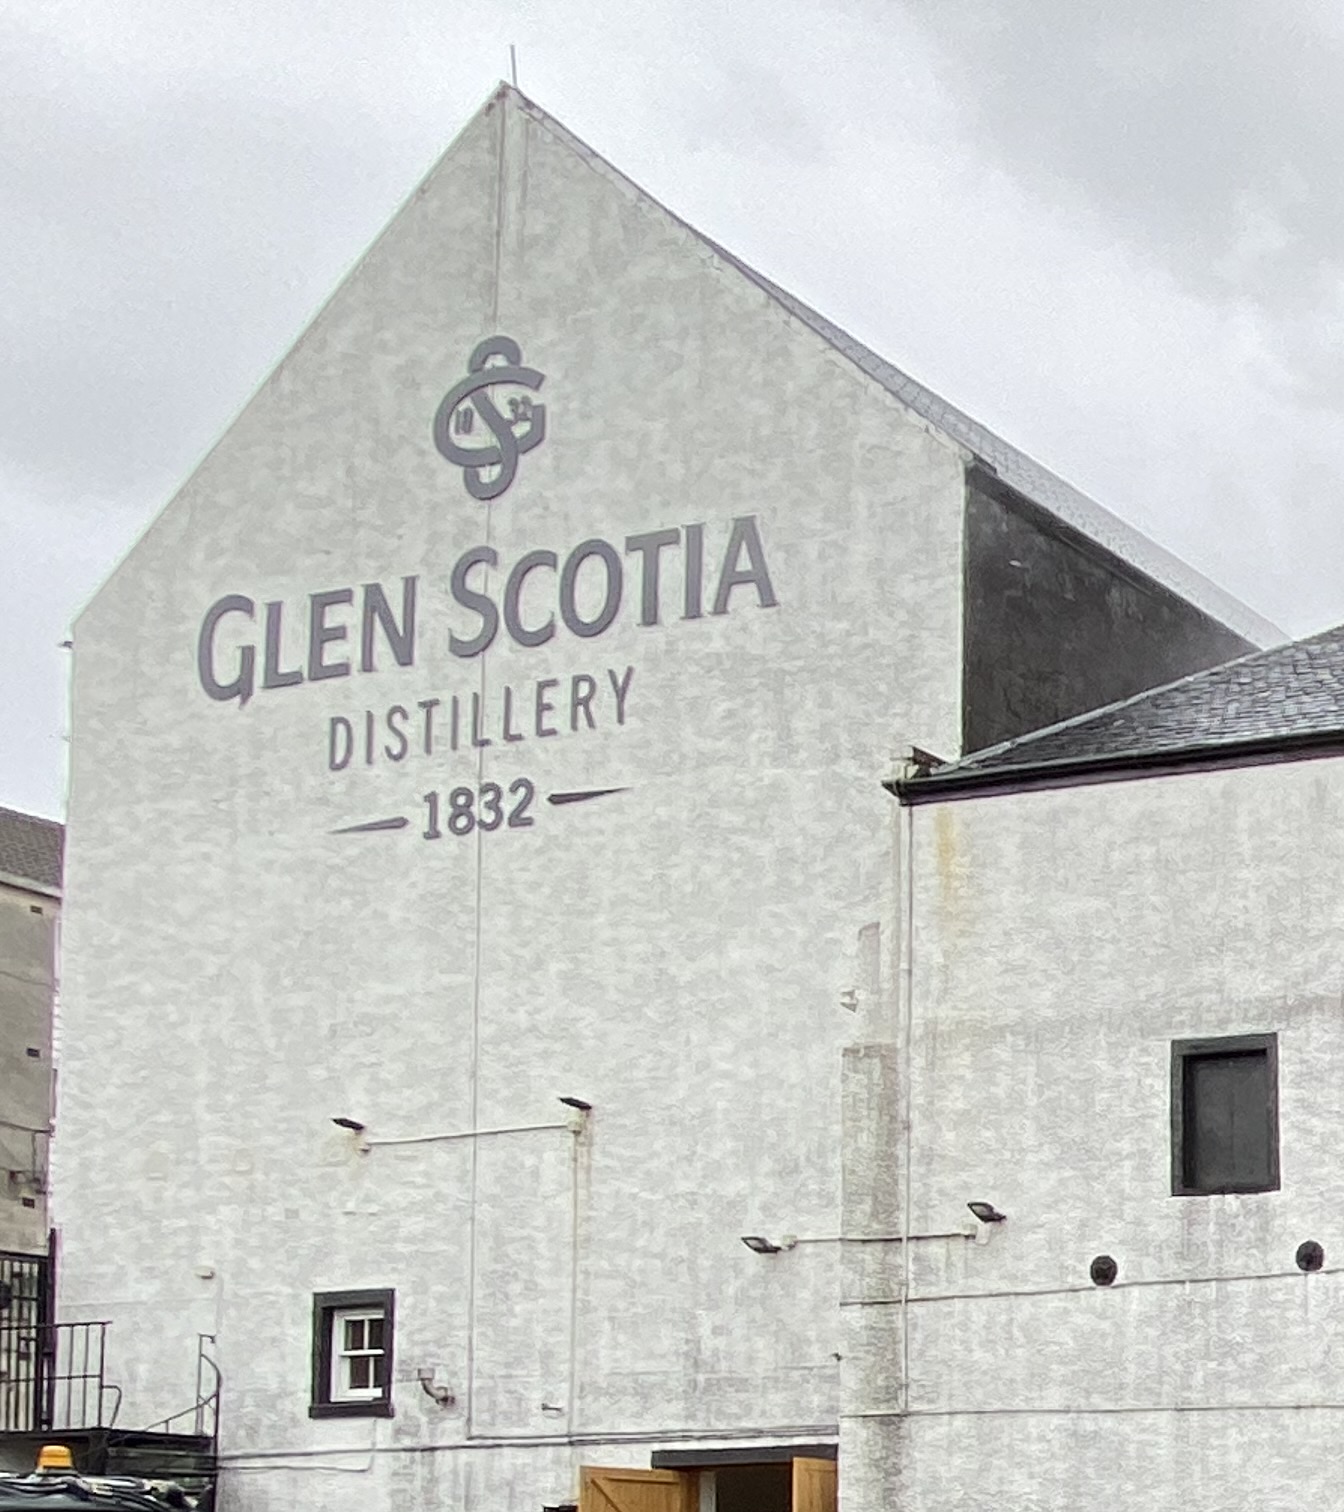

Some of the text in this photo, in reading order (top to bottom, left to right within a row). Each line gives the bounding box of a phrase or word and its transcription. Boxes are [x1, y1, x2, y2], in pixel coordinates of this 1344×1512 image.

[199, 514, 779, 708] GLEN SCOTIA
[328, 666, 634, 771] DISTILLERY
[422, 778, 535, 840] 1832
